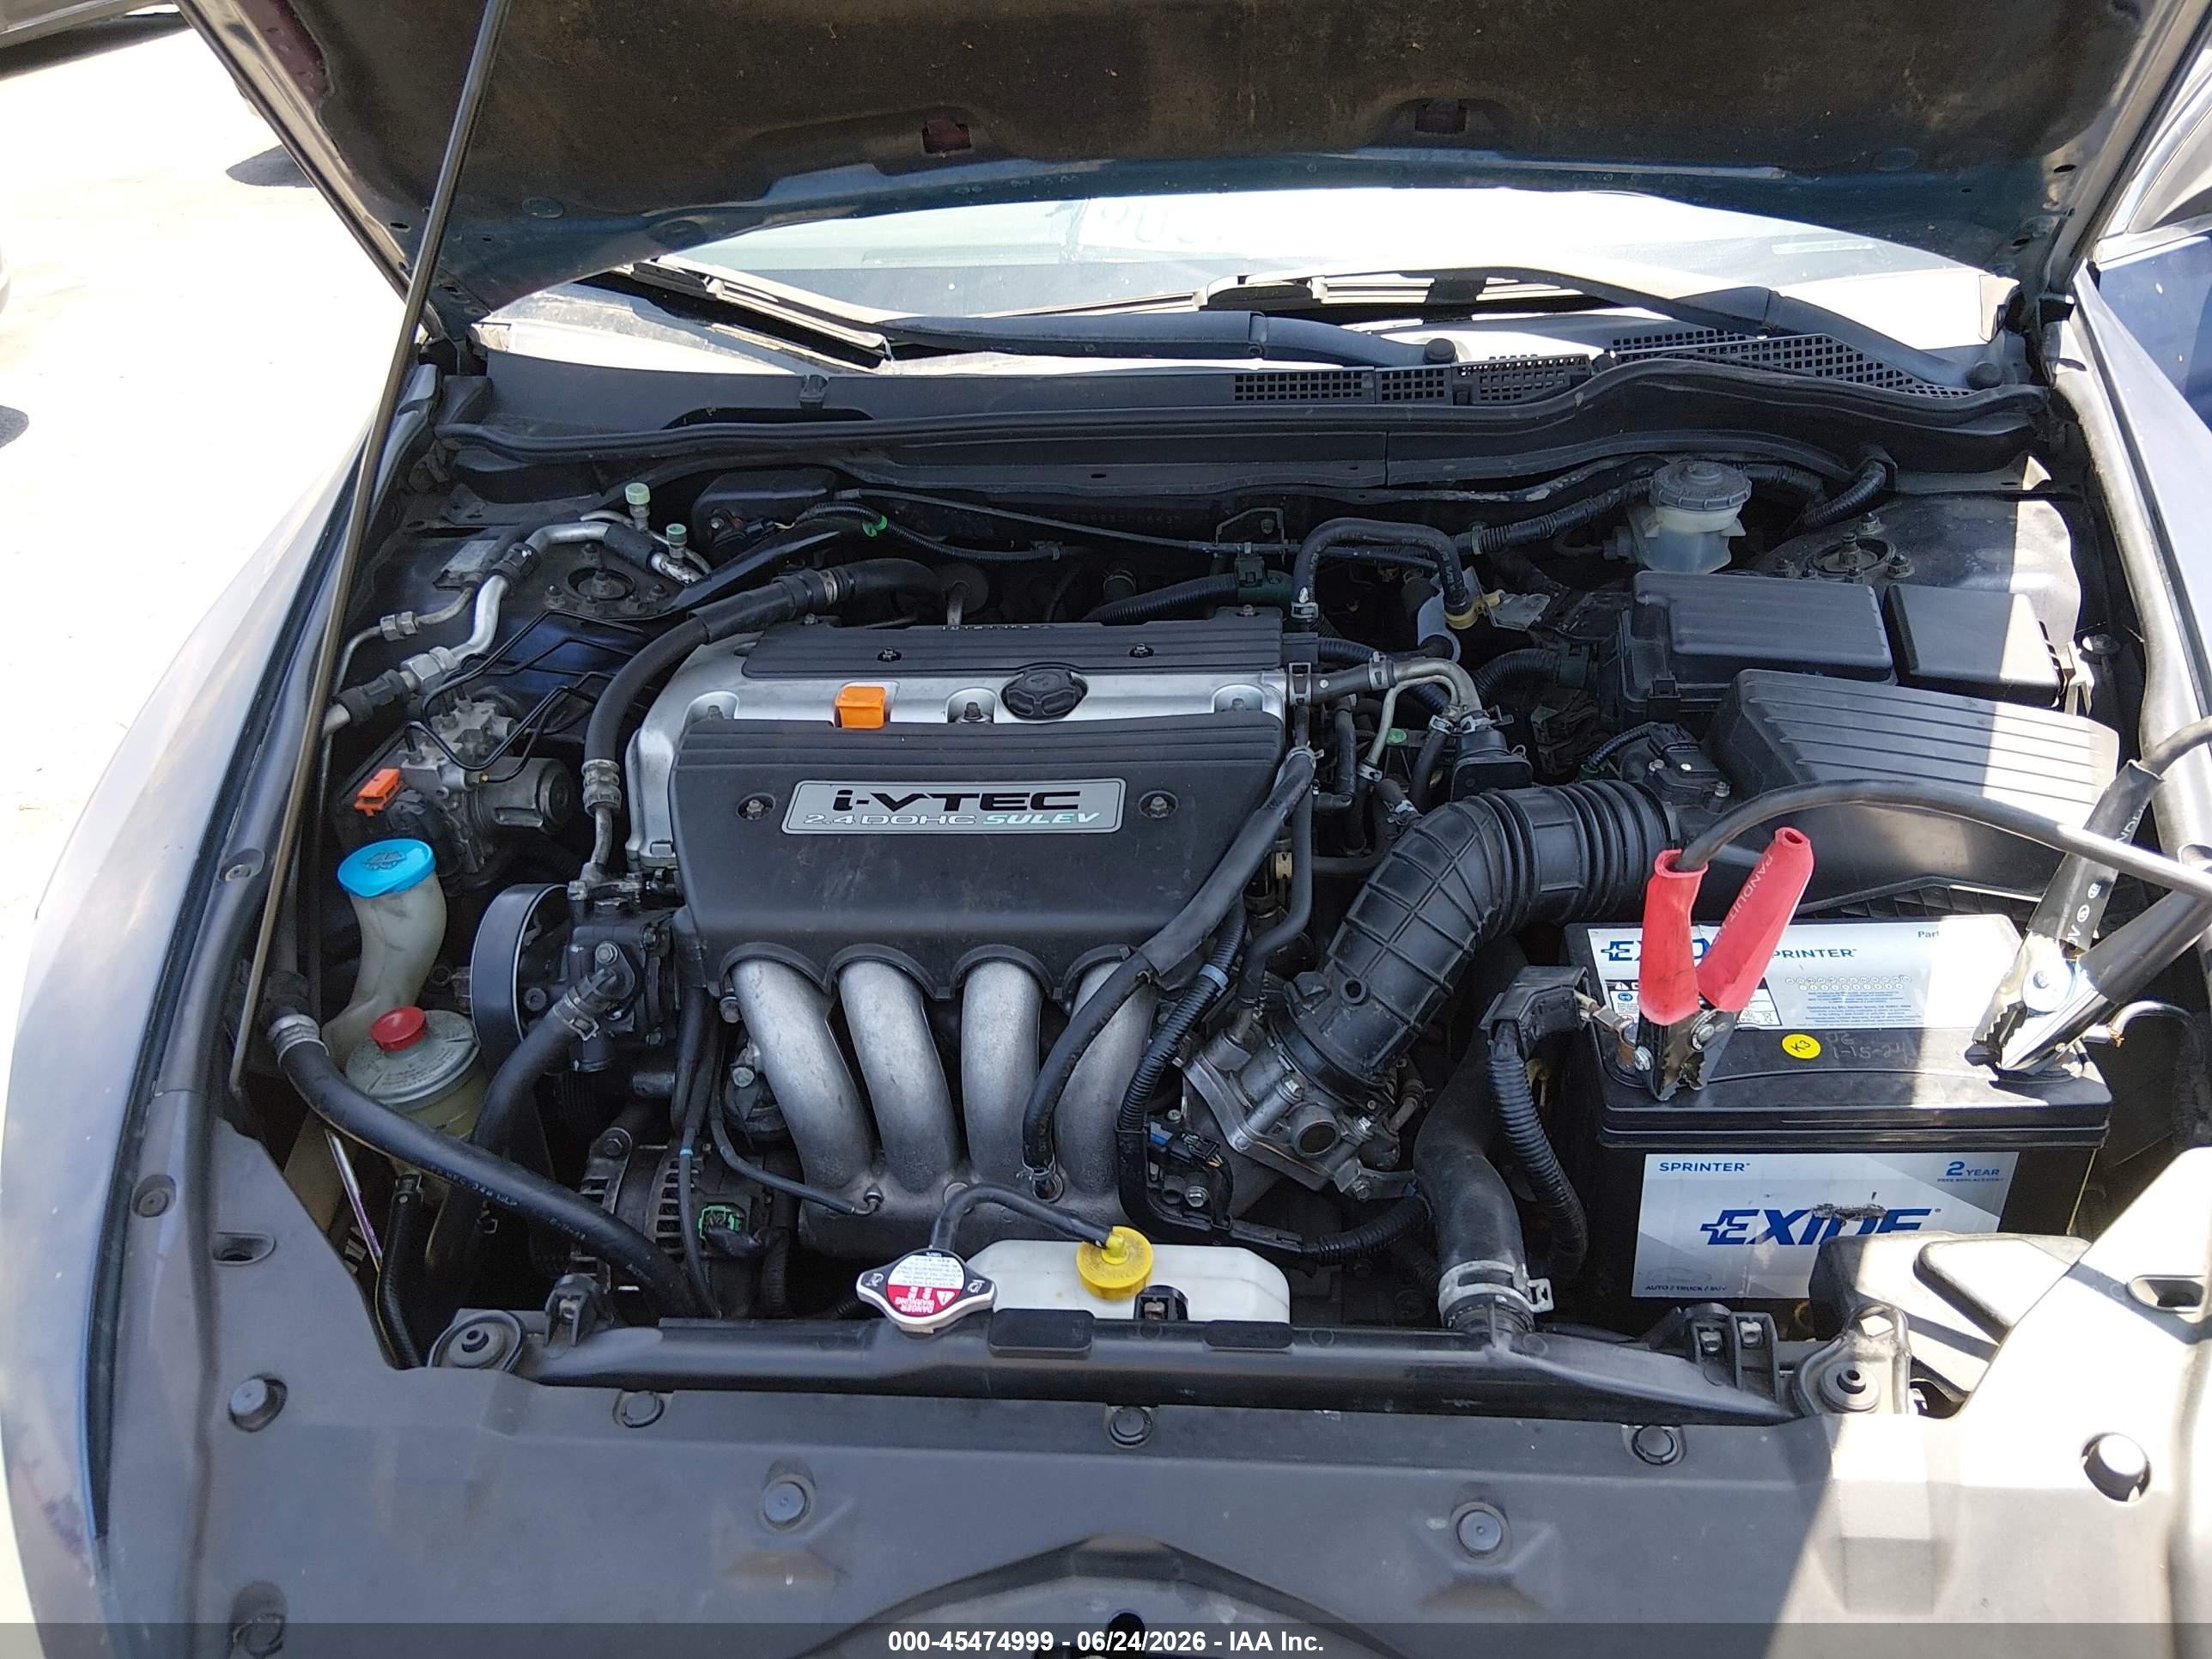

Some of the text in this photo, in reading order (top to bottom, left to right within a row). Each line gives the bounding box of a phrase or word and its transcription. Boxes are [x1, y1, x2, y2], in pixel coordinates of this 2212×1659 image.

[832, 788, 1081, 812] i-VTEC
[803, 811, 1101, 825] 2.4 DOHC SULEV
[1727, 853, 1774, 922] PANDUIT
[1771, 949, 1856, 958] PRINTER
[1790, 1040, 1811, 1053] K3
[1659, 1162, 1746, 1172] SPRINTER
[1947, 1161, 1965, 1176] 2
